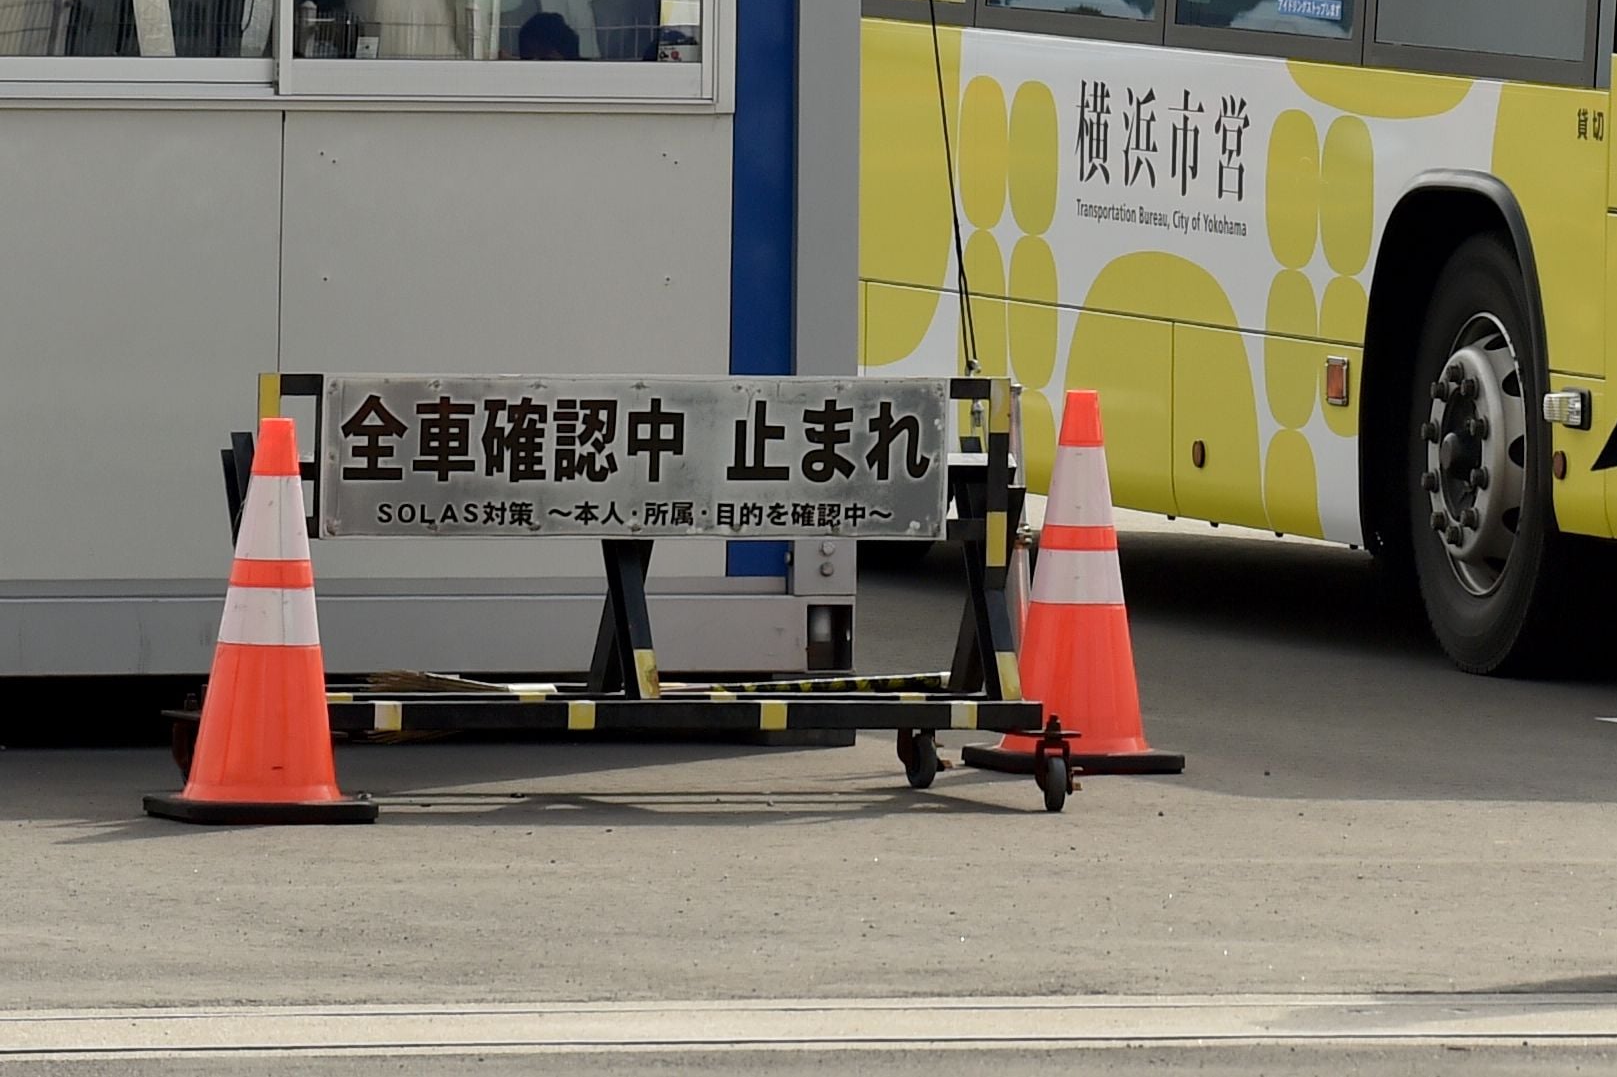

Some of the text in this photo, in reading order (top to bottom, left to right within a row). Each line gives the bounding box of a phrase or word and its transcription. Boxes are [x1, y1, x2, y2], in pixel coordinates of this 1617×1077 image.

[1075, 79, 1250, 202] 横浜市営
[1577, 108, 1604, 141] 貸切
[1076, 198, 1247, 237] Transportation Bureau, City of Yokohama
[341, 394, 930, 483] 全車確認中 止まれ
[377, 501, 534, 526] SOLAS対策
